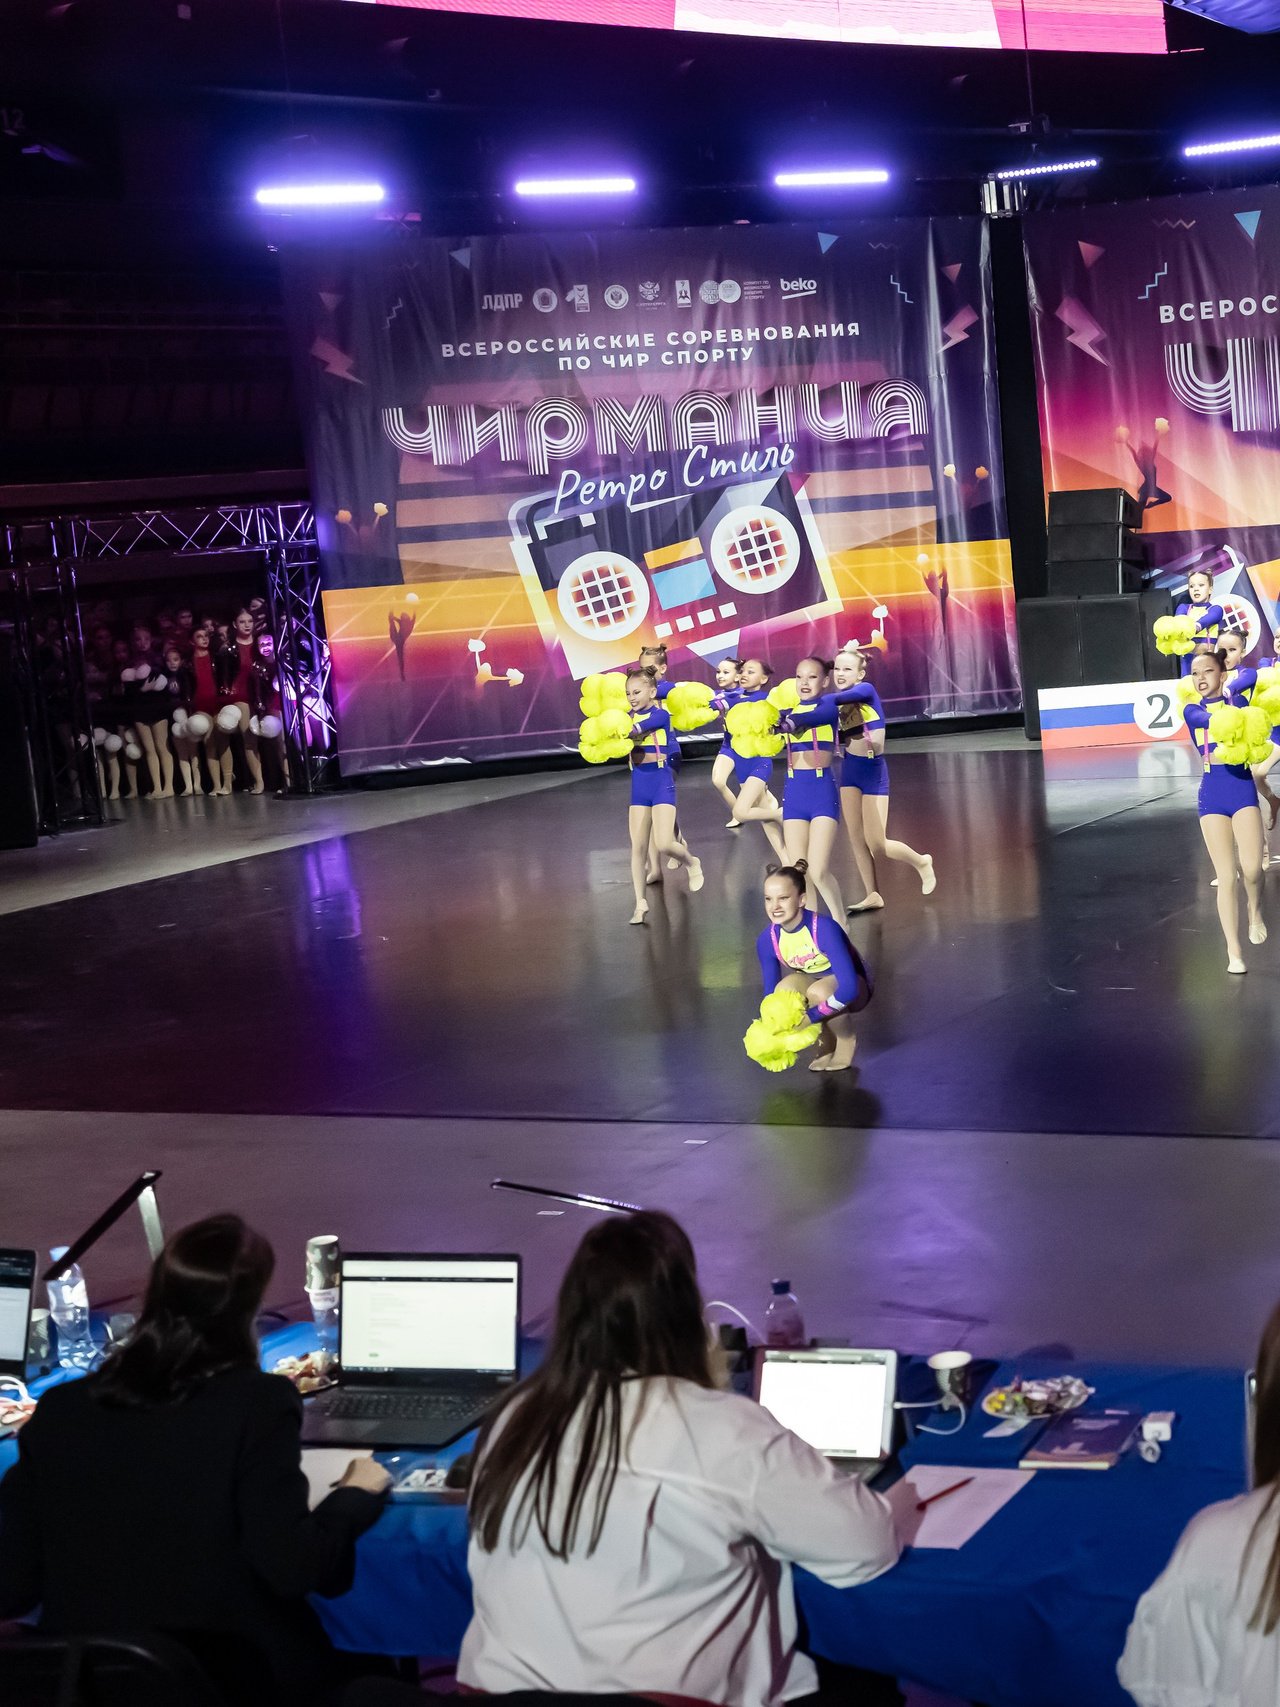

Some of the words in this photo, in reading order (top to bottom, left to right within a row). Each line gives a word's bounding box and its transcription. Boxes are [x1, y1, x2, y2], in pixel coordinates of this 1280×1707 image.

[780, 277, 817, 292] beko
[482, 293, 523, 312] ЛДПР
[441, 333, 656, 358] ВСЕРОССИЙСКИЕ
[666, 322, 860, 346] СОРЕВНОВАНИЯ
[558, 356, 591, 371] ПО
[602, 353, 650, 368] ЧИР
[661, 347, 754, 365] СПОРТУ
[553, 468, 668, 514] Ретро
[683, 444, 796, 487] Стиль
[1146, 693, 1174, 729] 2
